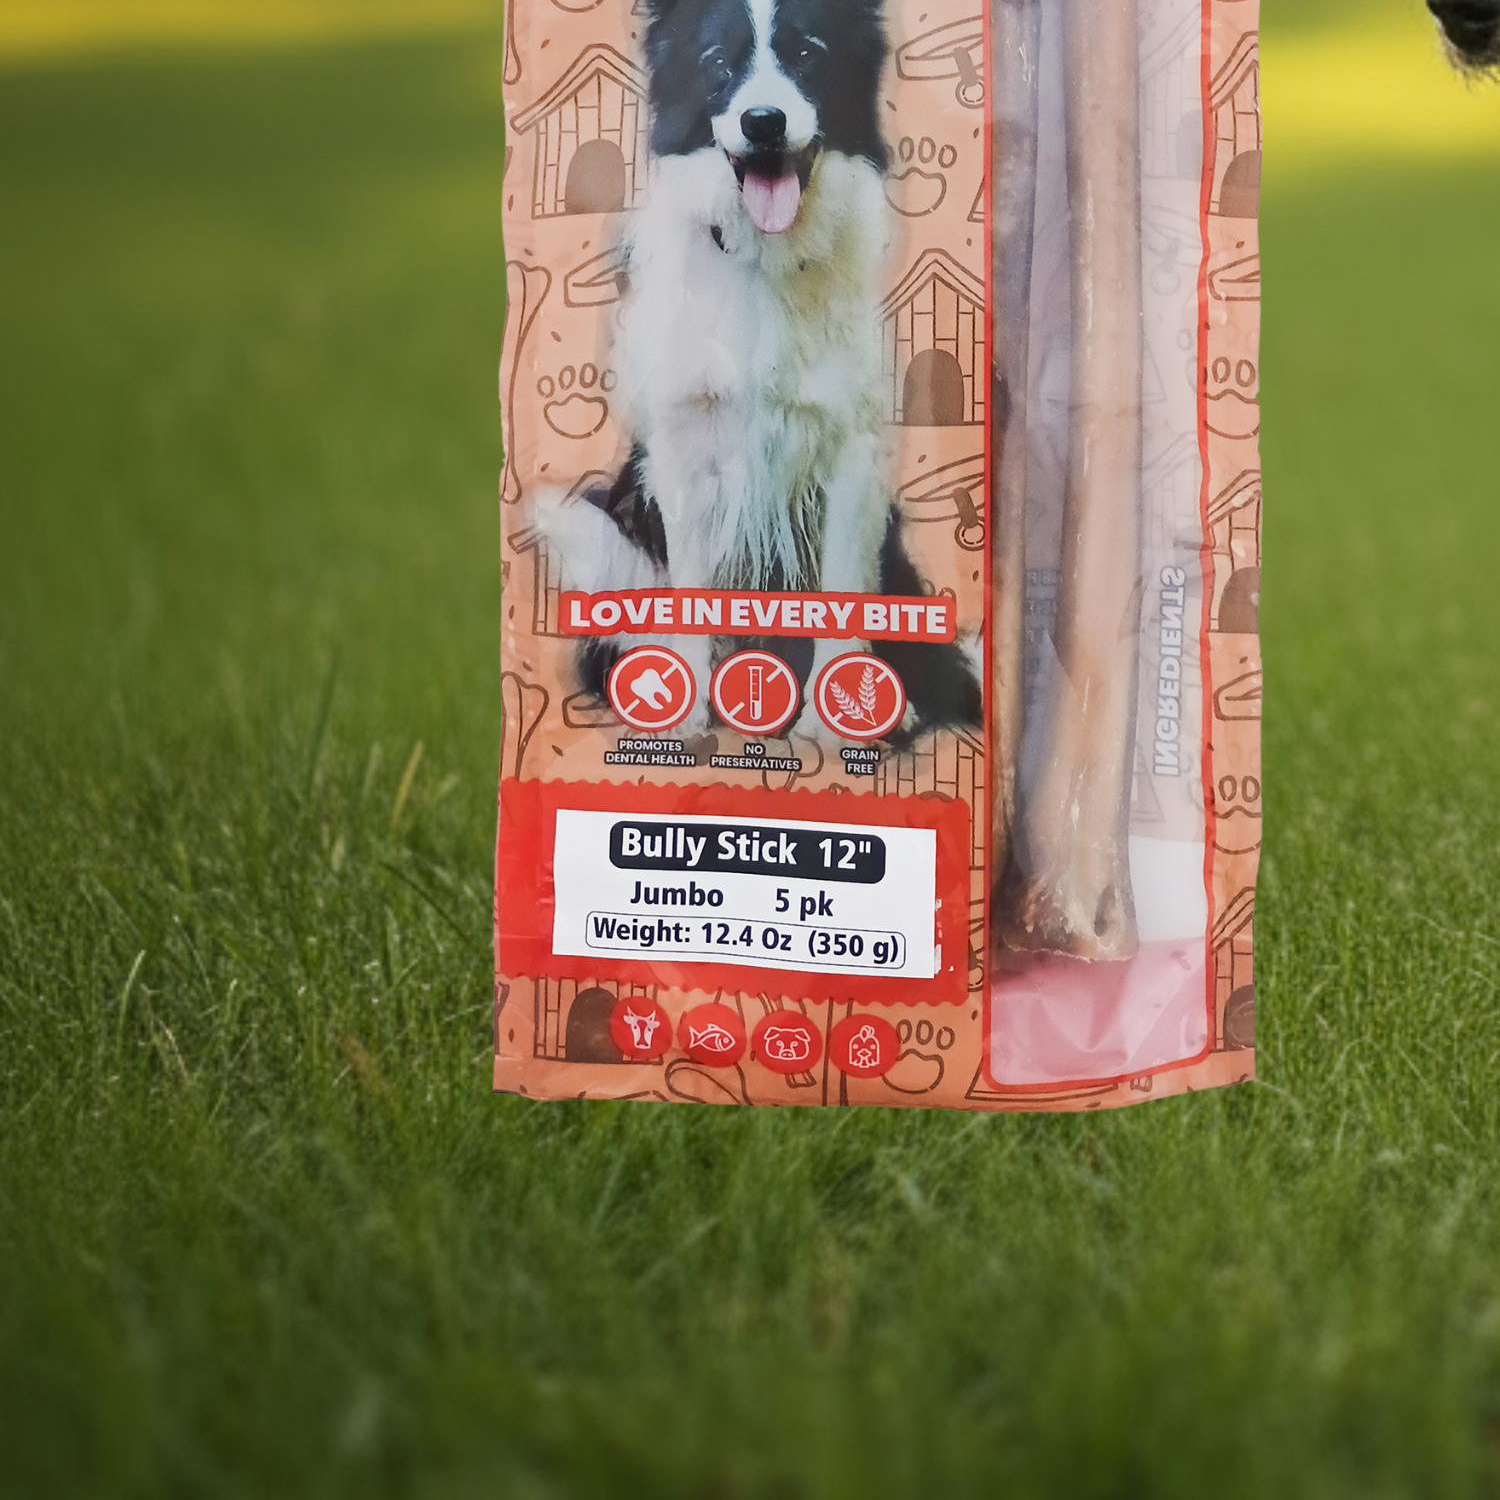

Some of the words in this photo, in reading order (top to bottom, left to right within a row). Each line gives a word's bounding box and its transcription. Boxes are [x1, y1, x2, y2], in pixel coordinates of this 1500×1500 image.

[570, 597, 674, 628] LOVE
[681, 597, 722, 626] IN
[730, 599, 856, 630] EVERY
[864, 602, 947, 634] BITE
[619, 740, 683, 752] PROMOTES
[745, 744, 764, 755] NO
[605, 753, 650, 765] DENTAL
[651, 754, 695, 766] HEALTH
[841, 749, 879, 761] GRAIN
[711, 756, 800, 770] PRESERVATIVES
[847, 763, 874, 774] FREE
[621, 826, 707, 867] Bully
[717, 830, 798, 865] Stick
[818, 838, 872, 870] 12"
[630, 881, 724, 908] Jumbo
[775, 889, 790, 913] 5
[800, 890, 834, 921] pk
[593, 916, 691, 947] Weight:
[701, 922, 753, 947] 12.4
[761, 926, 793, 951] Oz
[807, 930, 864, 958] (350
[873, 935, 899, 963] g)
